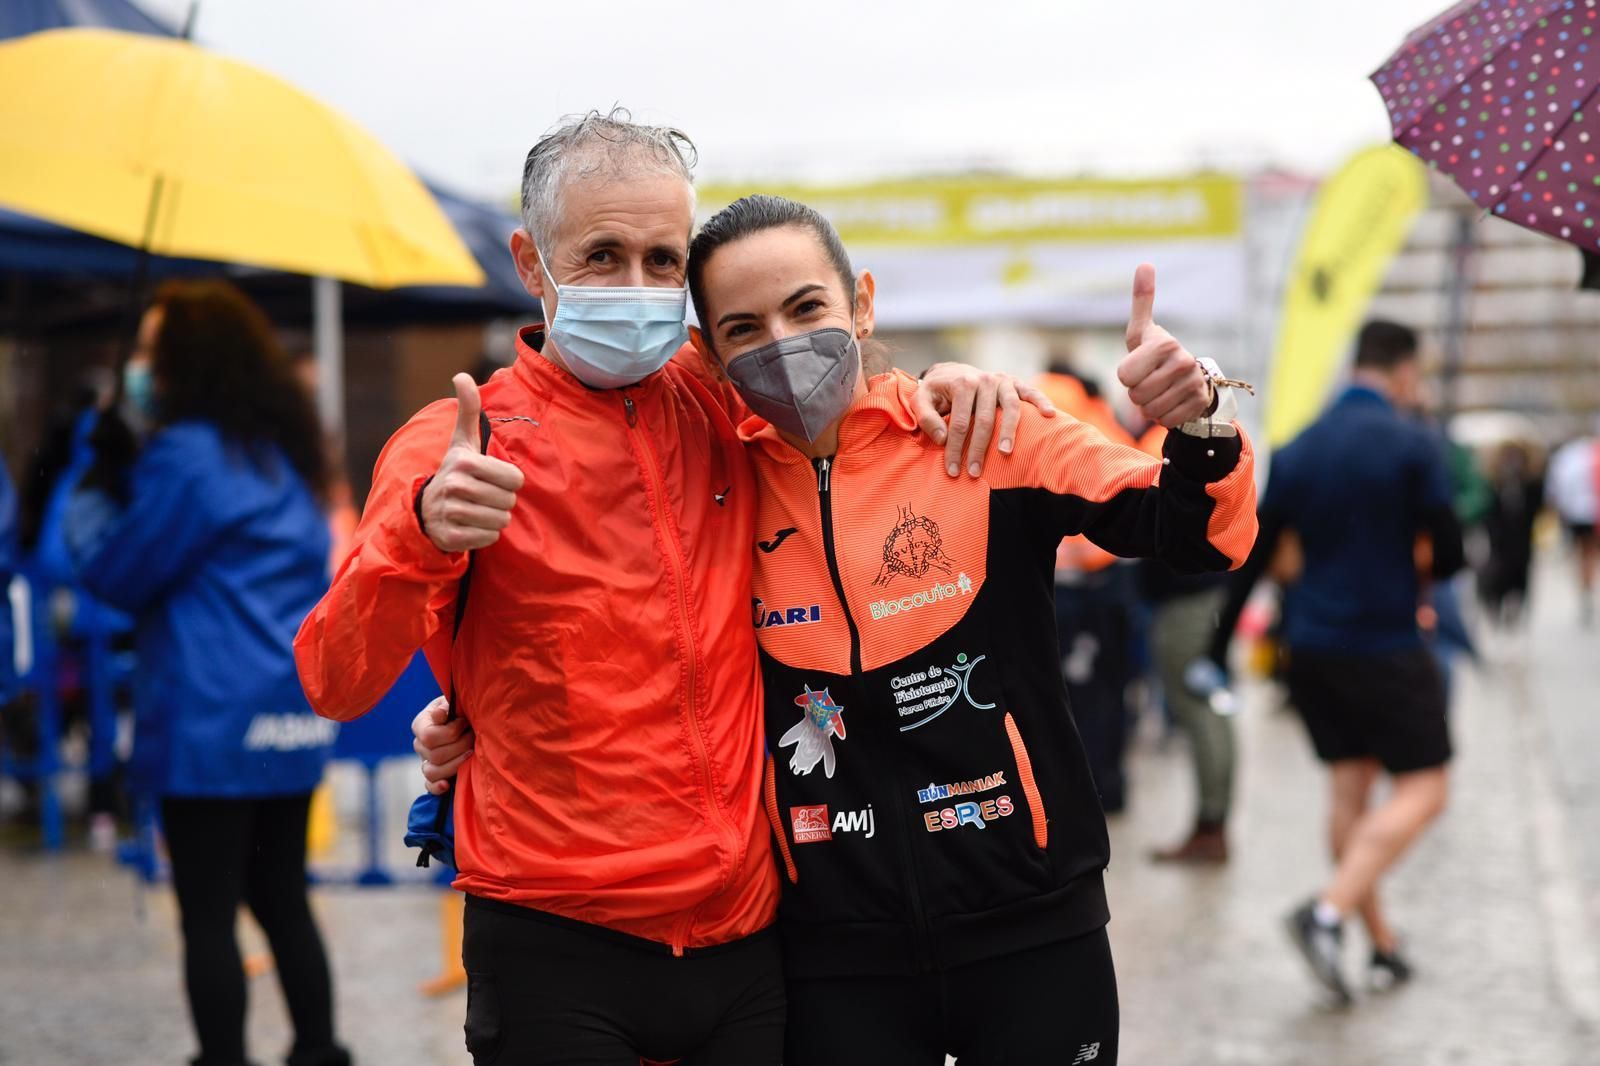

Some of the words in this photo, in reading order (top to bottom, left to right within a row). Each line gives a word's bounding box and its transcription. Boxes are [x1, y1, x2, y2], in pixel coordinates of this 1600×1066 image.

[869, 582, 957, 619] Biocouto
[890, 672, 927, 690] Centro
[928, 665, 942, 679] de
[893, 677, 957, 705] Fisioterapia
[917, 771, 1007, 803] RUNMANIAK
